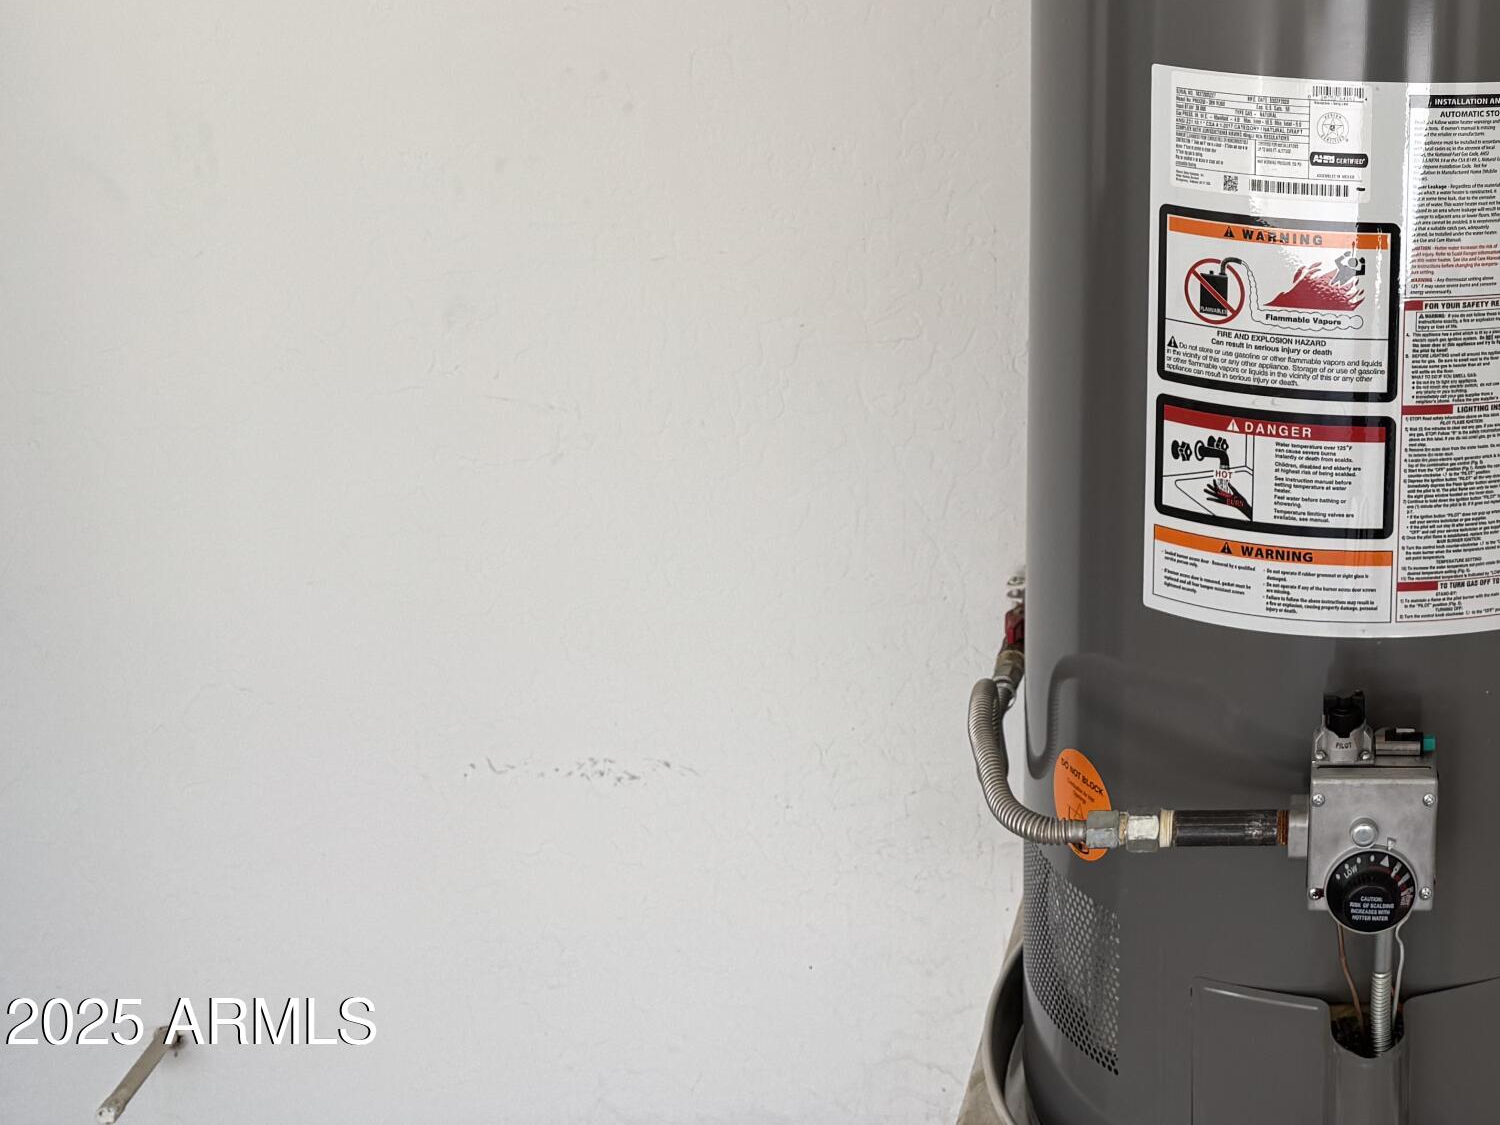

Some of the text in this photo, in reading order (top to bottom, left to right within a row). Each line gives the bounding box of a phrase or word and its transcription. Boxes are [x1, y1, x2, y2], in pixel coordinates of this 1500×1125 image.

[1434, 96, 1488, 106] INSTALLATION
[1440, 109, 1484, 118] AUTOMATIC
[1242, 229, 1324, 246] WARNING
[1424, 302, 1438, 310] FOR
[1441, 300, 1460, 309] YOUR
[1462, 299, 1488, 308] SAFETY
[1265, 313, 1342, 327] Flammable Vapors
[1211, 338, 1224, 346] Can
[1225, 340, 1244, 348] result
[1254, 342, 1279, 351] serious
[1280, 345, 1300, 355] injury
[1312, 347, 1332, 355] death
[1217, 331, 1326, 347] FIRE AND EXPLOSION HAZARD
[1182, 350, 1200, 361] vicinity
[1208, 354, 1219, 362] this
[1228, 358, 1239, 366] any
[1240, 359, 1256, 367] other
[1292, 364, 1318, 373] Storage
[1357, 367, 1386, 376] gasoline
[1198, 345, 1213, 353] store
[1234, 350, 1260, 361] gasoline
[1269, 354, 1286, 362] other
[1287, 356, 1321, 364] flammable
[1361, 360, 1382, 368] liquids
[1172, 356, 1186, 364] other
[1218, 364, 1239, 373] vapors
[1248, 367, 1268, 376] liquids
[1288, 371, 1311, 381] vicinity
[1341, 375, 1354, 383] any
[1204, 369, 1220, 378] result
[1229, 373, 1251, 382] serious
[1252, 376, 1269, 385] injury
[1278, 378, 1298, 386] death.
[1457, 403, 1488, 413] LIGHTING
[1244, 421, 1313, 438] DANGER
[1215, 470, 1233, 479] HOT
[1240, 545, 1313, 563] WARNING
[1440, 581, 1447, 589] TO
[1449, 580, 1465, 588] TURN
[1466, 578, 1478, 587] GAS
[1479, 577, 1490, 586] OFF
[1492, 576, 1499, 584] TO
[1069, 765, 1082, 780] NOT
[1081, 774, 1104, 796] BLOCK
[1343, 864, 1359, 879] LOW
